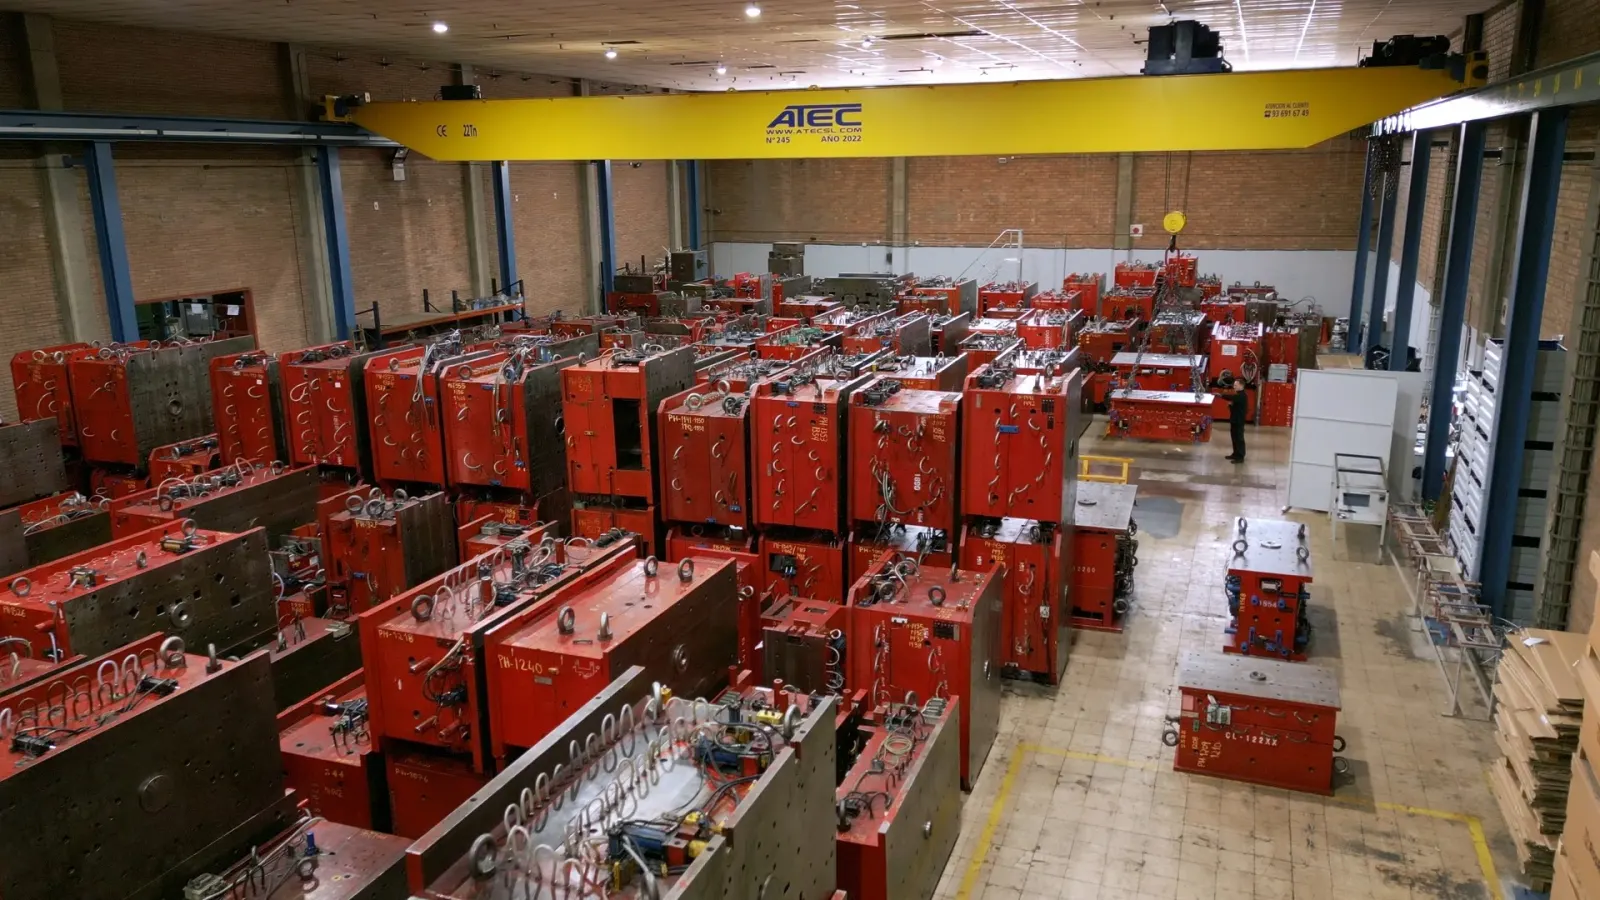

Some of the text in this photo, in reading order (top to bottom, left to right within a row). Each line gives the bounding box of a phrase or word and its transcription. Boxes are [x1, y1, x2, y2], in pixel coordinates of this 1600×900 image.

[766, 103, 862, 128] ATEC
[820, 134, 840, 142] AÑO
[497, 654, 543, 674] PH-1240
